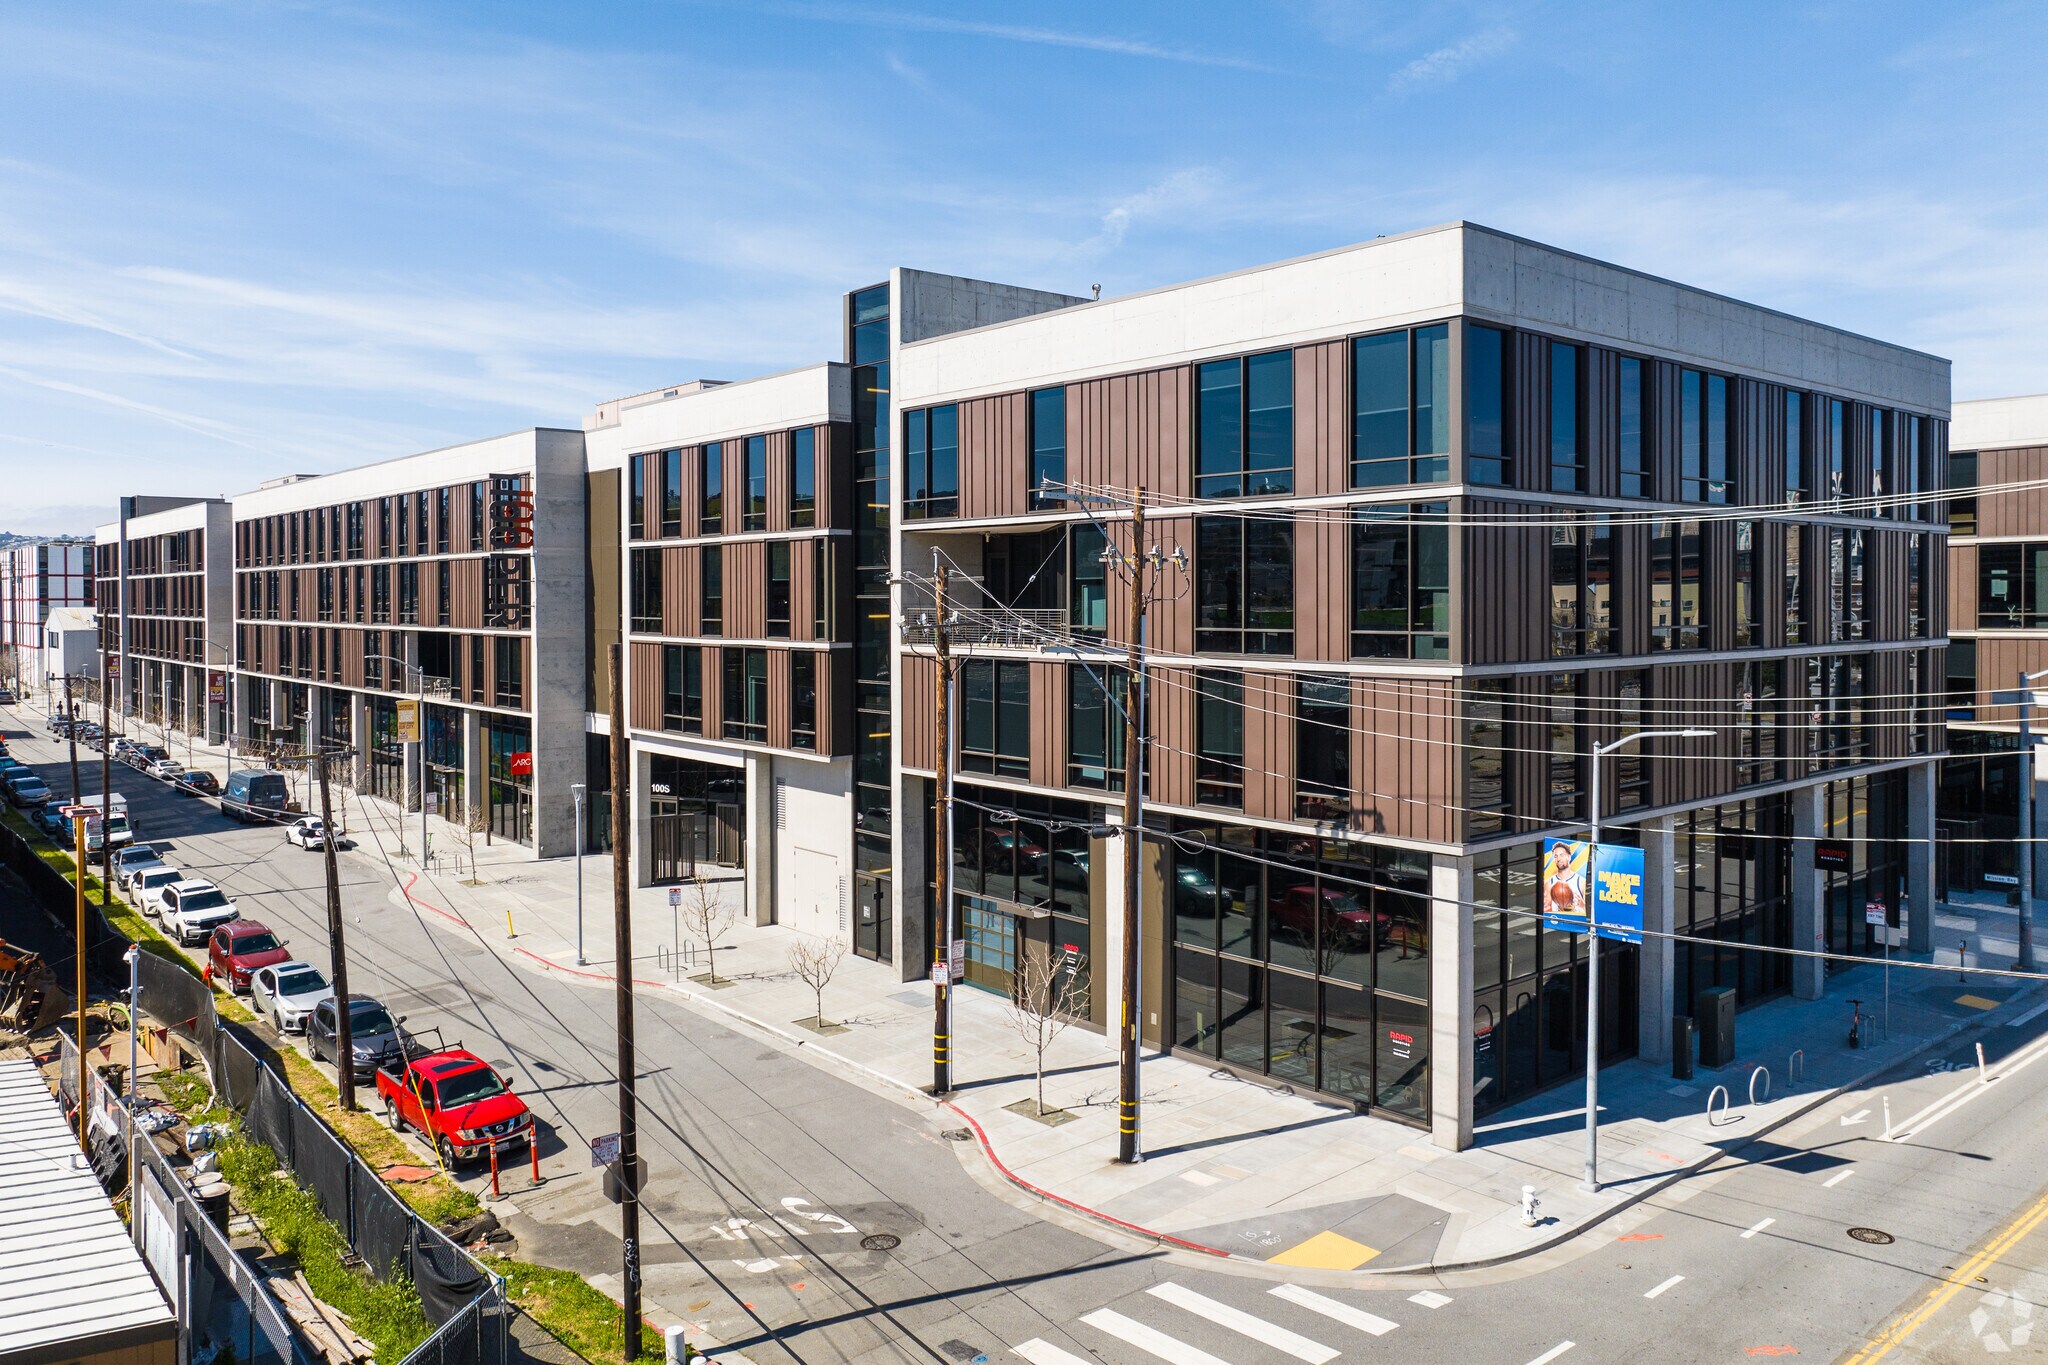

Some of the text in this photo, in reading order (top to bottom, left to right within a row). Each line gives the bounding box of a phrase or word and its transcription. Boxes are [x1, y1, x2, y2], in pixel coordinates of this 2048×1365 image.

[513, 758, 531, 767] ARC
[651, 783, 670, 793] 100S
[1818, 848, 1847, 858] RAPID
[1598, 871, 1640, 886] MAKE
[1599, 890, 1638, 905] LOOK
[1390, 1031, 1413, 1043] RAPID
